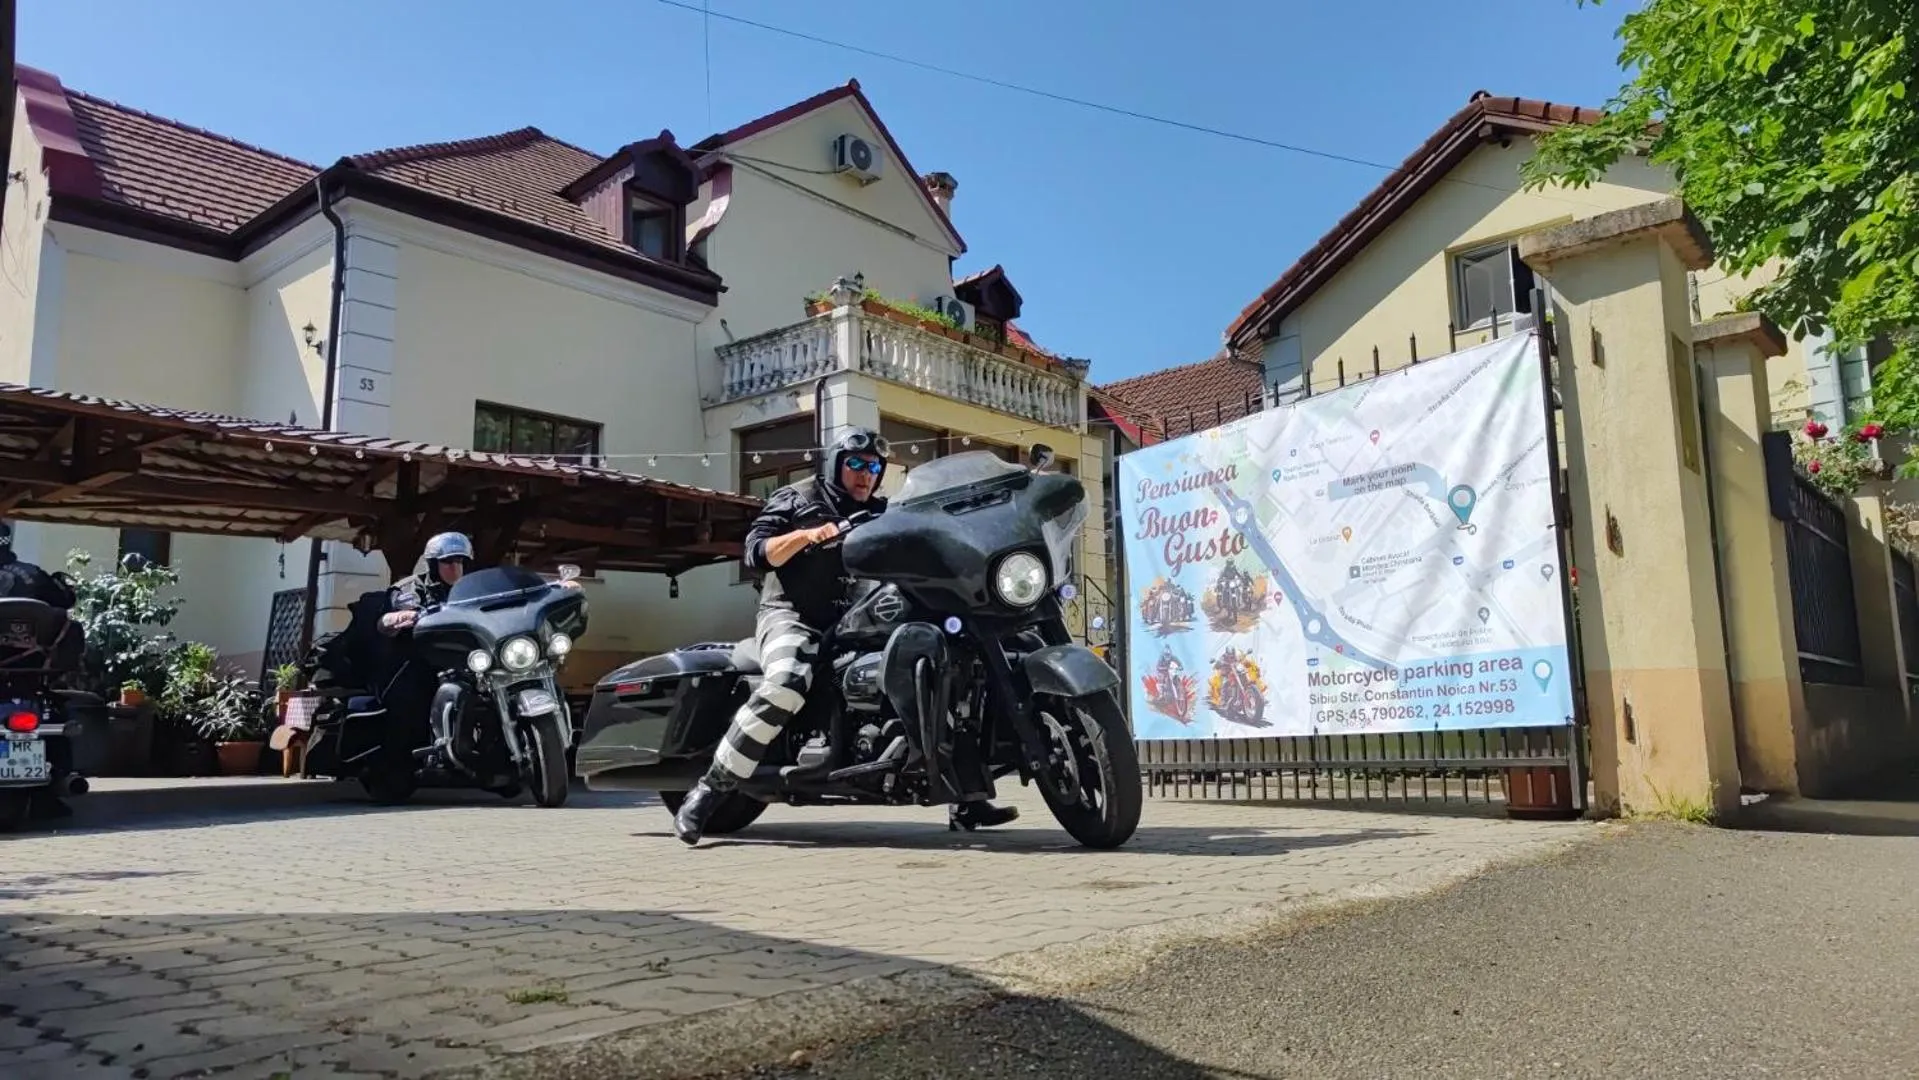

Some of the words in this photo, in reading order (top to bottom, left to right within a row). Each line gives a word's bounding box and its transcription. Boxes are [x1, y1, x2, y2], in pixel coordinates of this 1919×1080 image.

[360, 378, 374, 391] 53
[1136, 464, 1239, 503] Pensiunea
[1343, 474, 1365, 486] Mark
[1367, 470, 1388, 482] your
[1392, 462, 1417, 477] point
[1354, 486, 1365, 495] on
[1368, 480, 1384, 492] the
[1385, 476, 1407, 488] map
[1135, 506, 1213, 540] Buon
[1164, 528, 1249, 577] Gusto
[1308, 666, 1399, 687] Motorcycle
[1404, 660, 1473, 683] parking
[1479, 657, 1523, 673] area
[1309, 692, 1337, 705] Sibiu
[1340, 691, 1360, 703] Str.
[1364, 686, 1433, 702] Constantin
[1437, 683, 1475, 697] Noica
[1433, 699, 1515, 718] 24.152998
